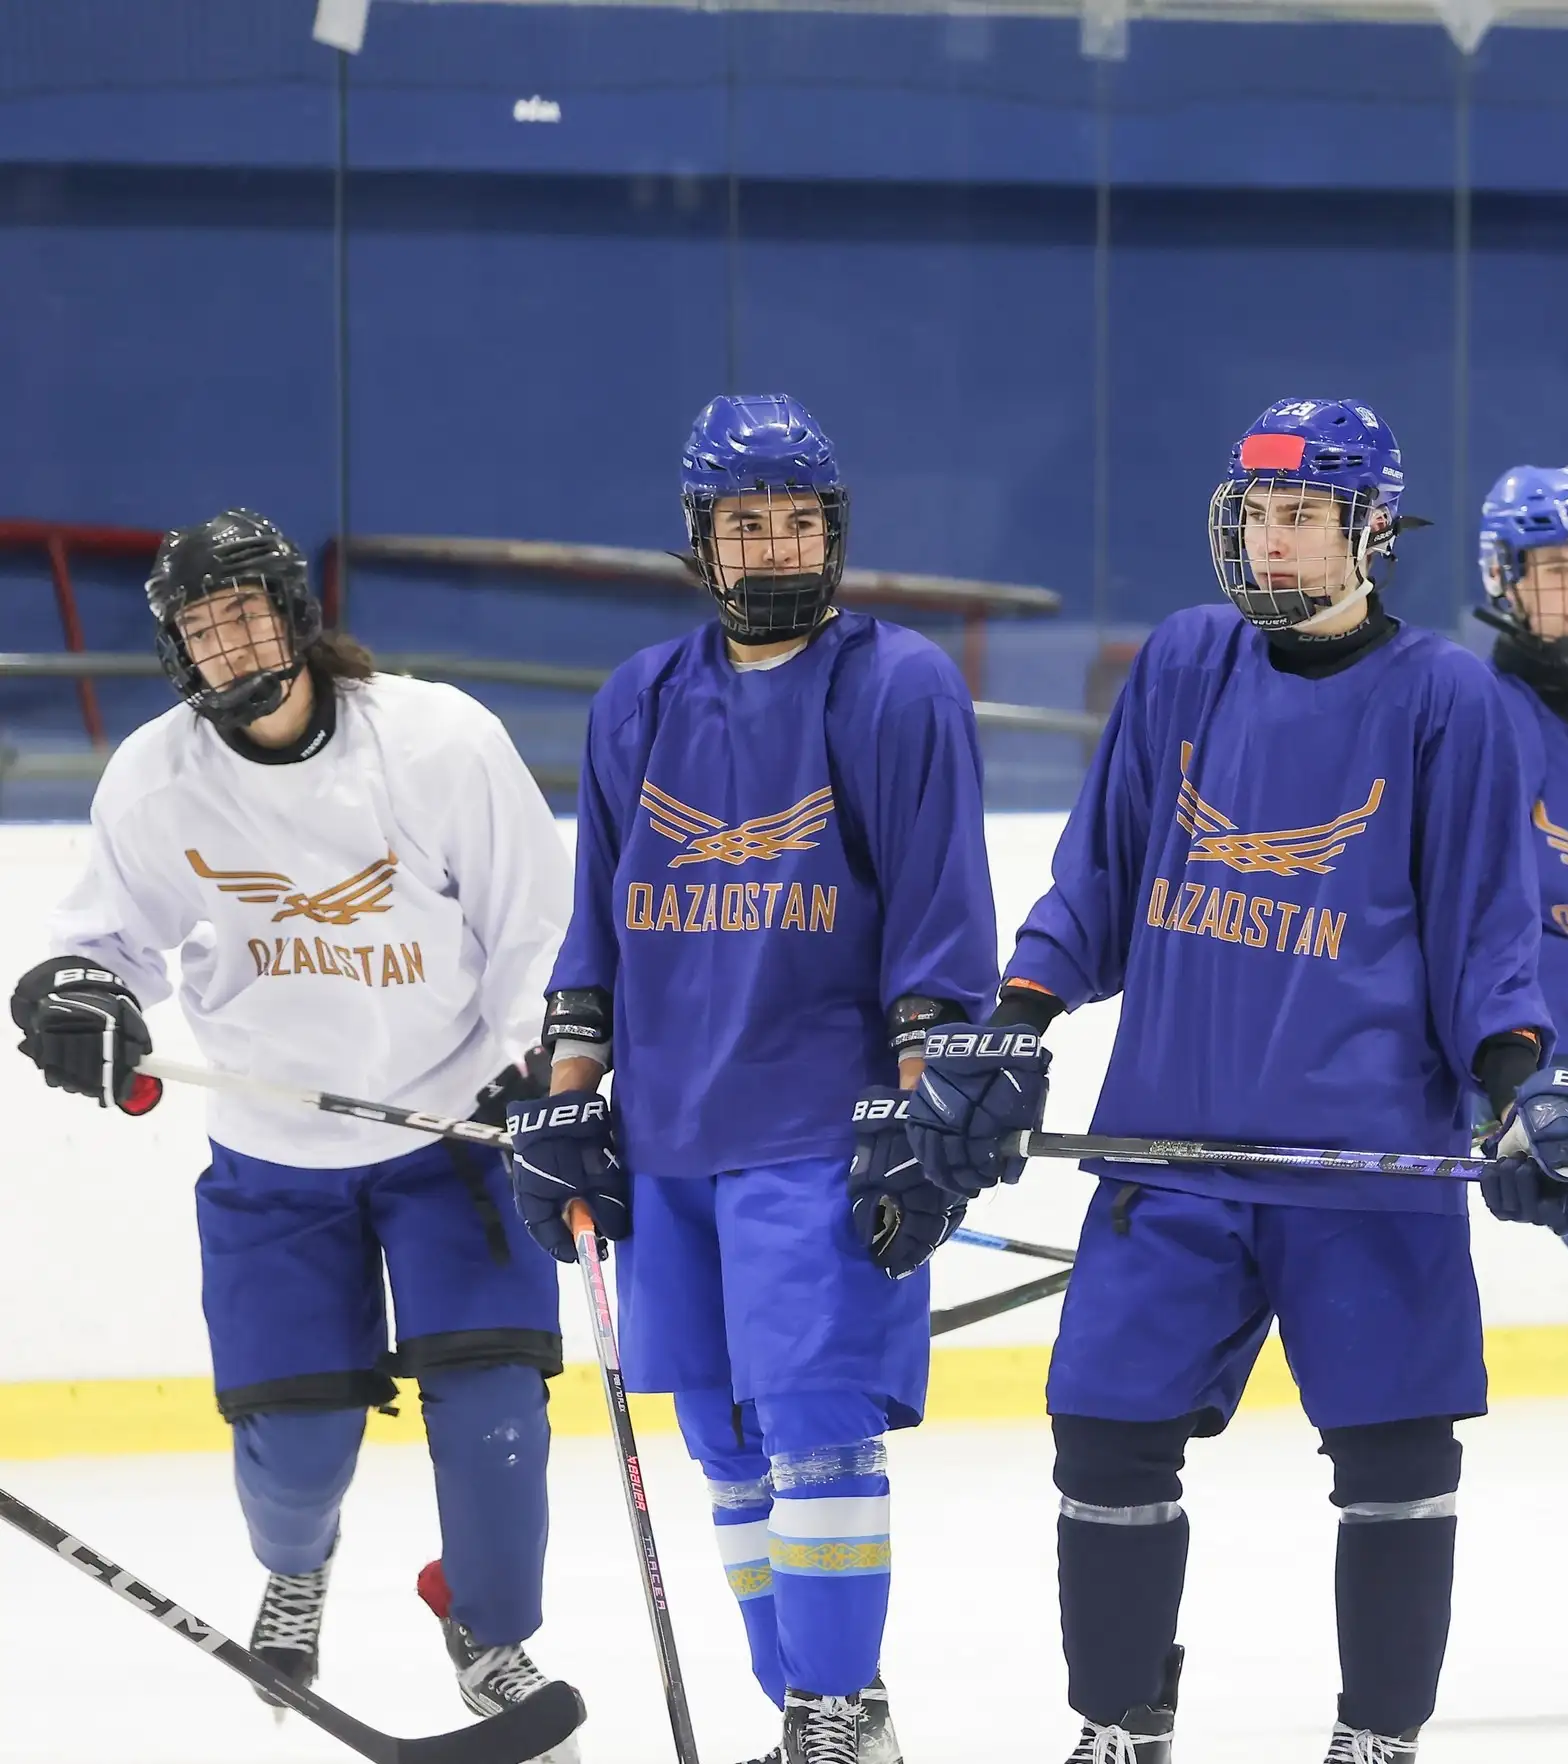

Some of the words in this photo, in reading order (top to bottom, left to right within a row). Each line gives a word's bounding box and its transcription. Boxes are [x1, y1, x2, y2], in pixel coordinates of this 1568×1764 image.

[1382, 466, 1404, 480] BAUER
[720, 615, 768, 637] AUER
[626, 882, 838, 933] QAZAQSTAN
[1147, 877, 1347, 960] QAZAQSTAN
[924, 1033, 1041, 1059] BAUE
[506, 1101, 604, 1136] AUER
[628, 1464, 646, 1512] BAUER
[57, 1535, 231, 1653] CCM
[643, 1535, 667, 1610] TRACER
